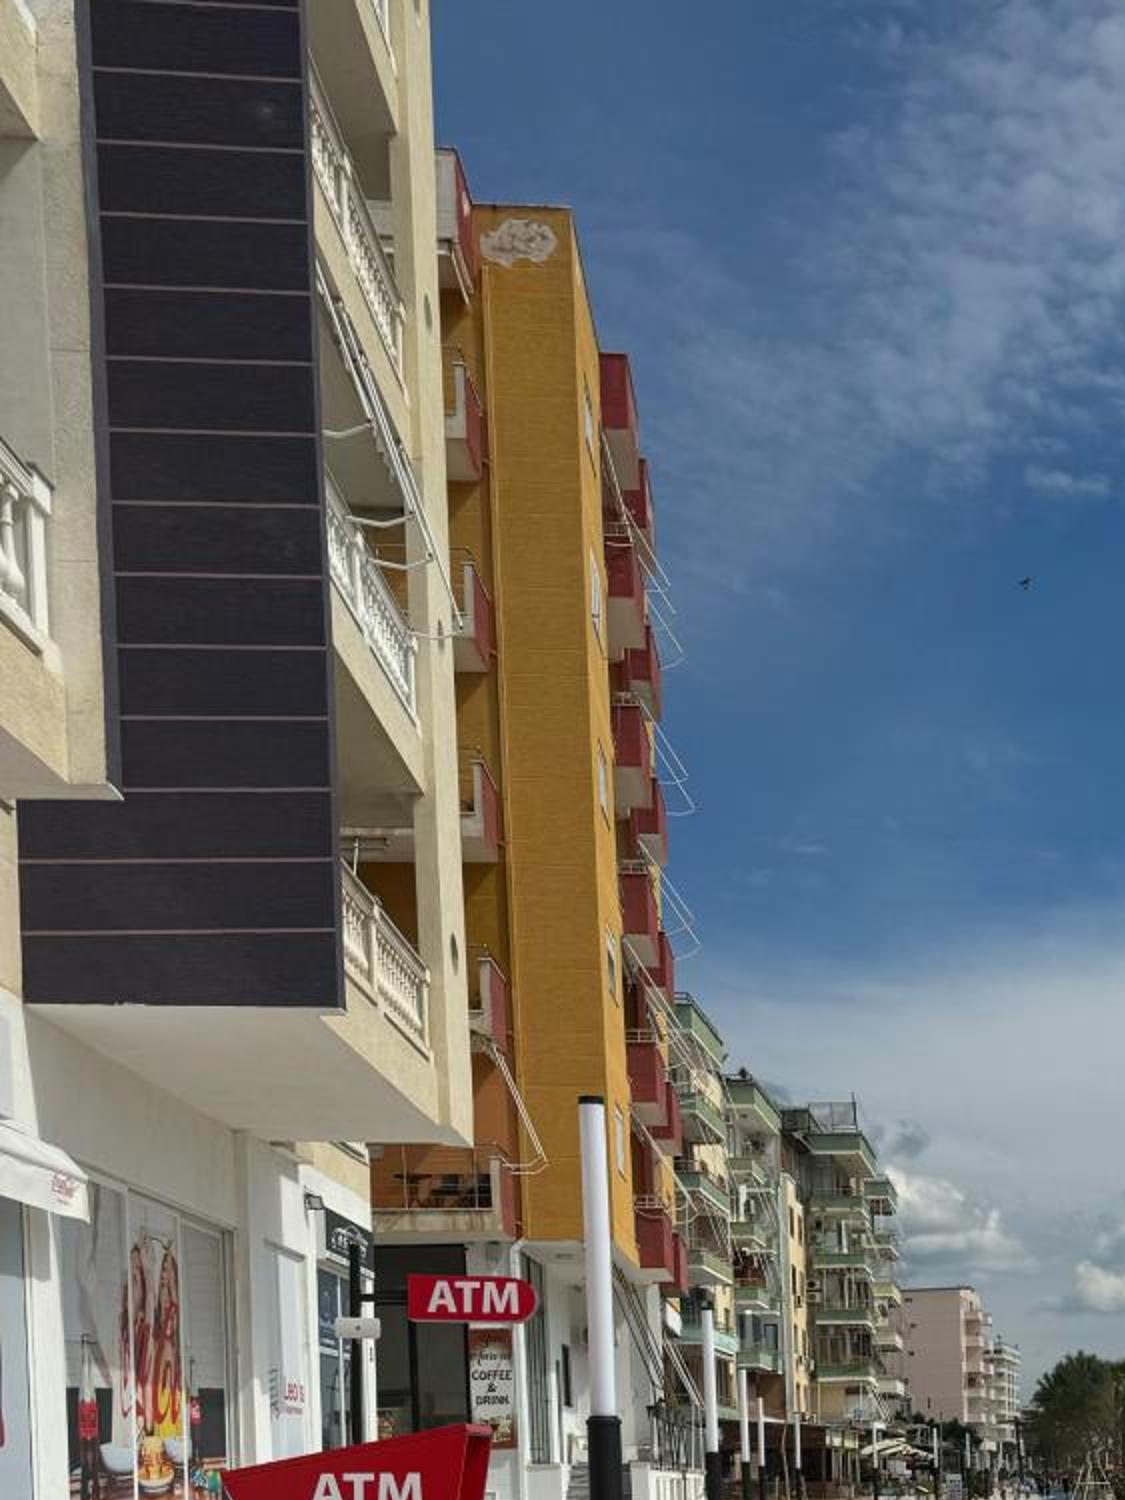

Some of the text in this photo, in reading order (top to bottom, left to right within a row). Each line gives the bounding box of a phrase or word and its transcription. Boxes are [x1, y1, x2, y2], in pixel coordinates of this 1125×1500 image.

[427, 1280, 520, 1315] ATM
[471, 1369, 513, 1381] COFFEE
[487, 1382, 498, 1393] &
[475, 1395, 511, 1406] DRINK
